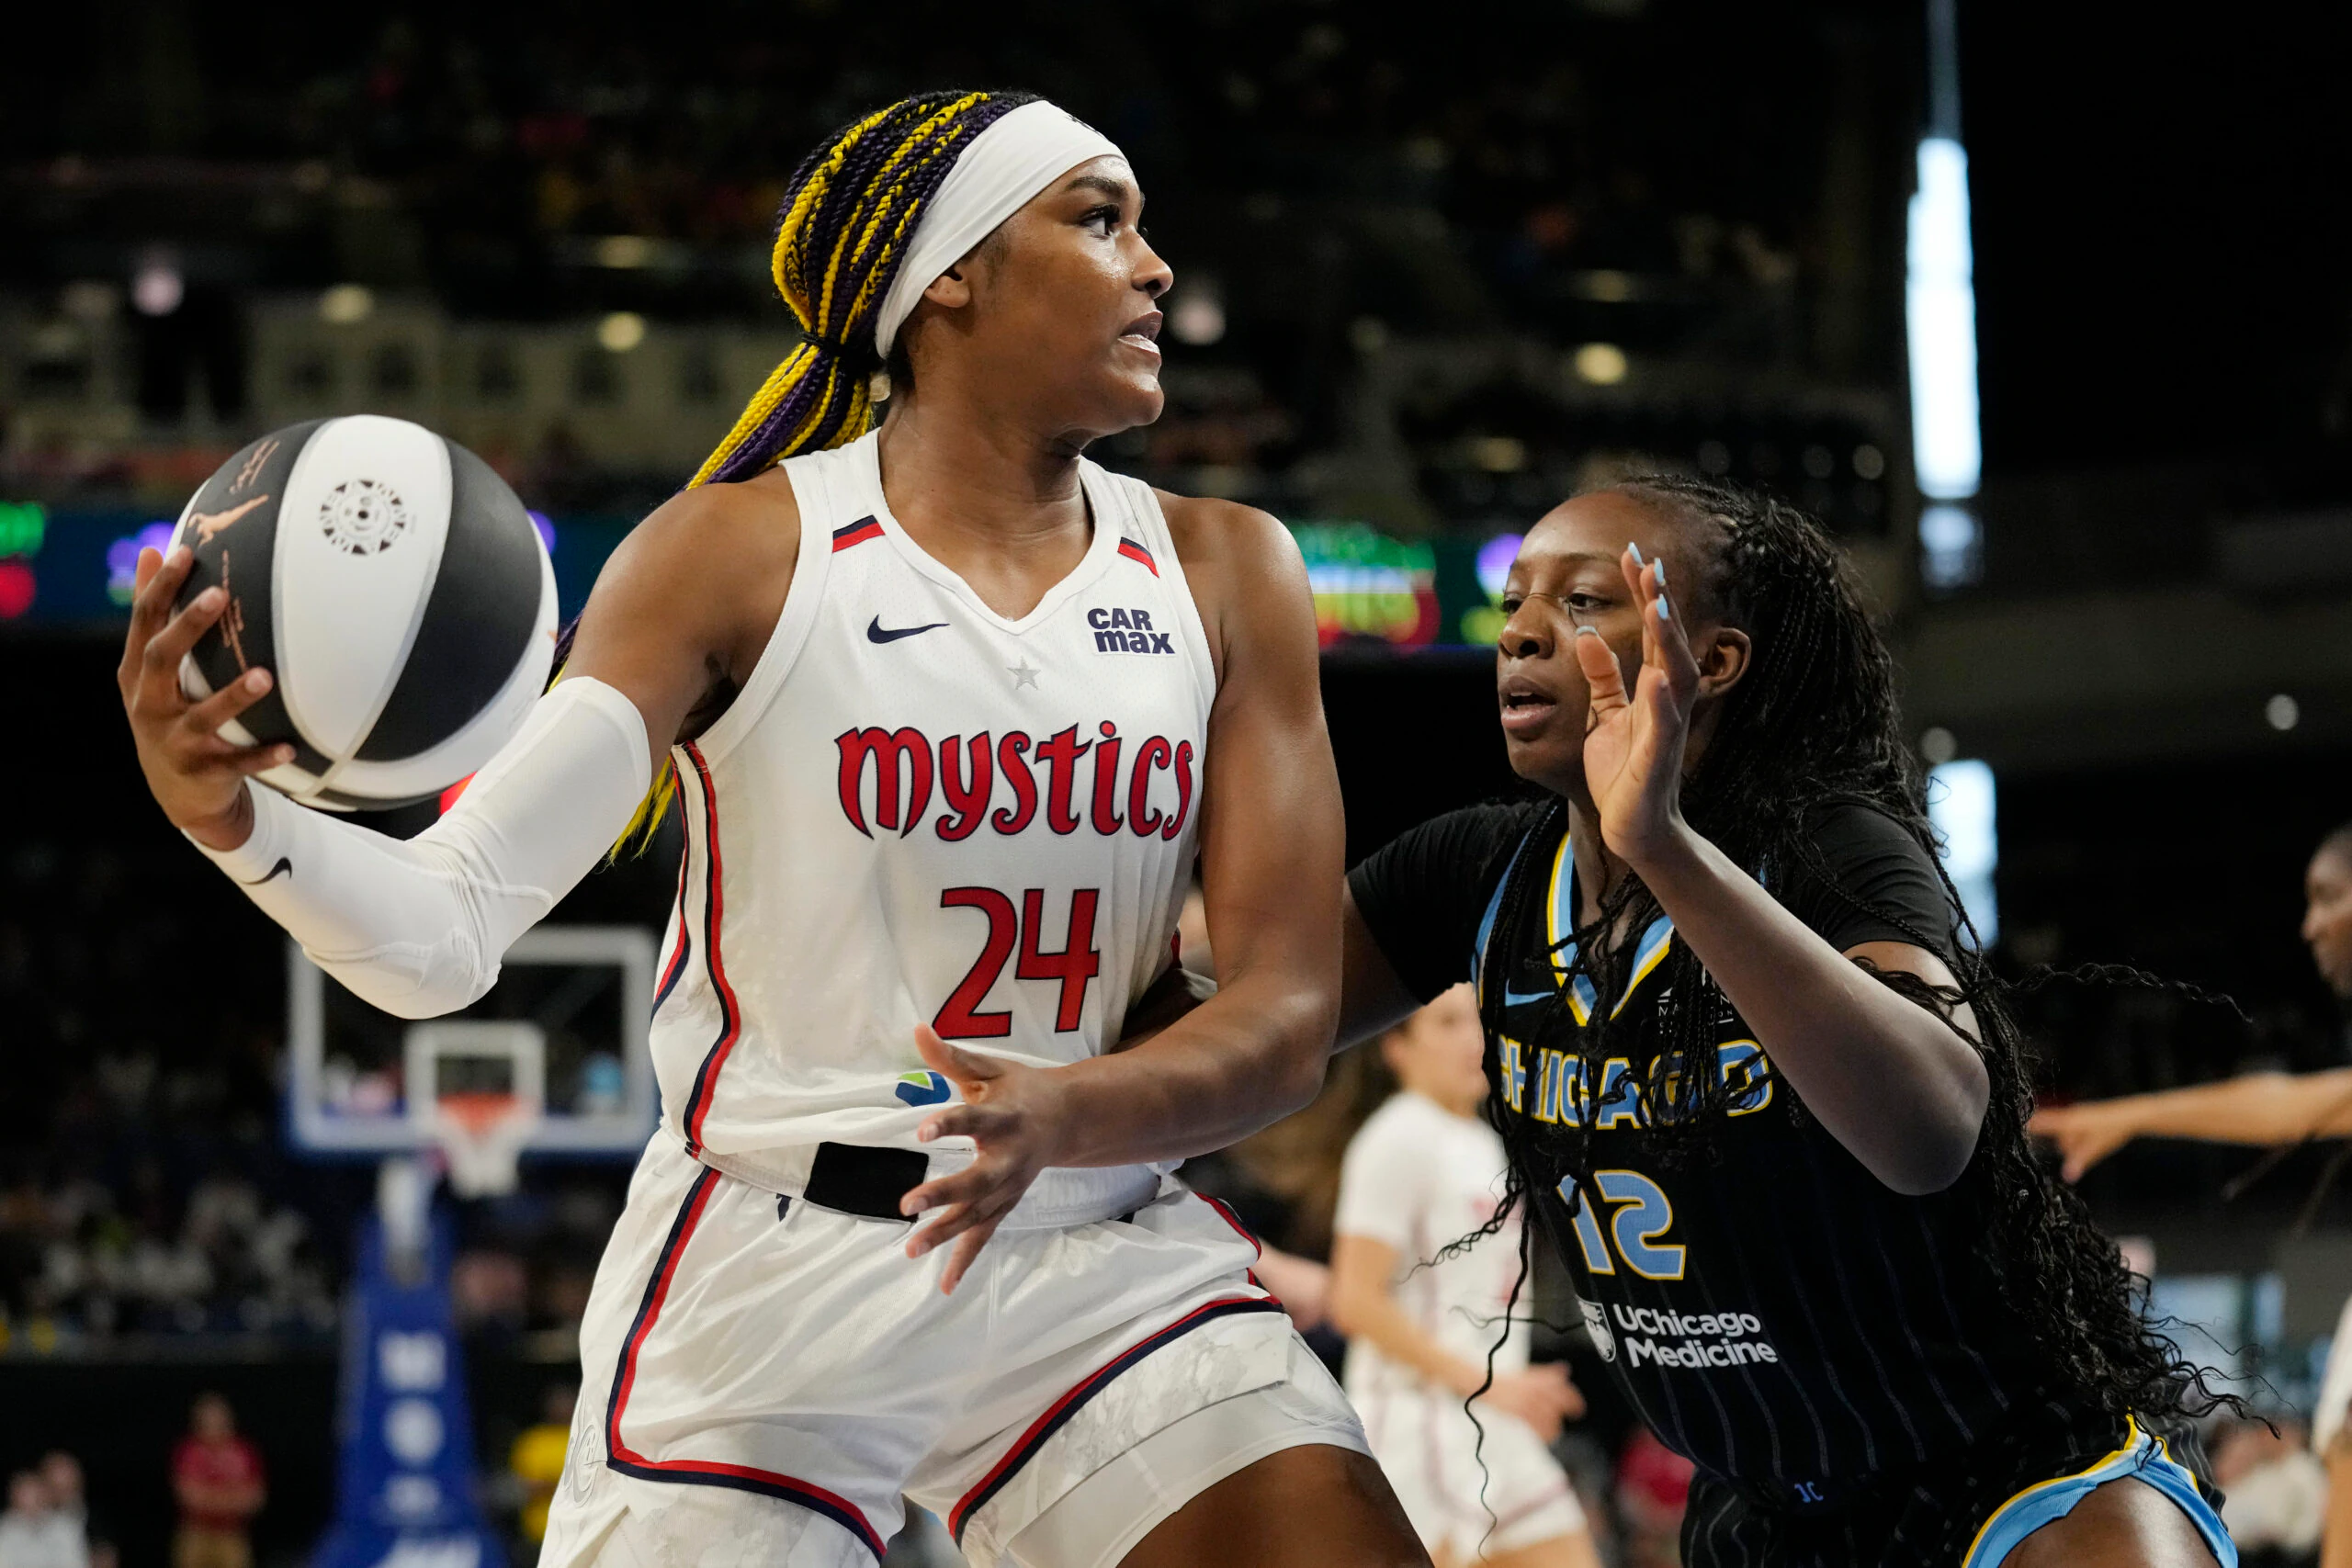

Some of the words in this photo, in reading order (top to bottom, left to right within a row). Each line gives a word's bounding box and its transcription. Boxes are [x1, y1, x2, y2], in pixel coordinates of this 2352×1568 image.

[1087, 607, 1154, 631] CAR
[1093, 630, 1176, 655] max
[931, 886, 1101, 1040] 24
[1556, 1169, 1687, 1281] 12
[1612, 1303, 1762, 1337] UChicago
[1623, 1337, 1779, 1369] Medicine
